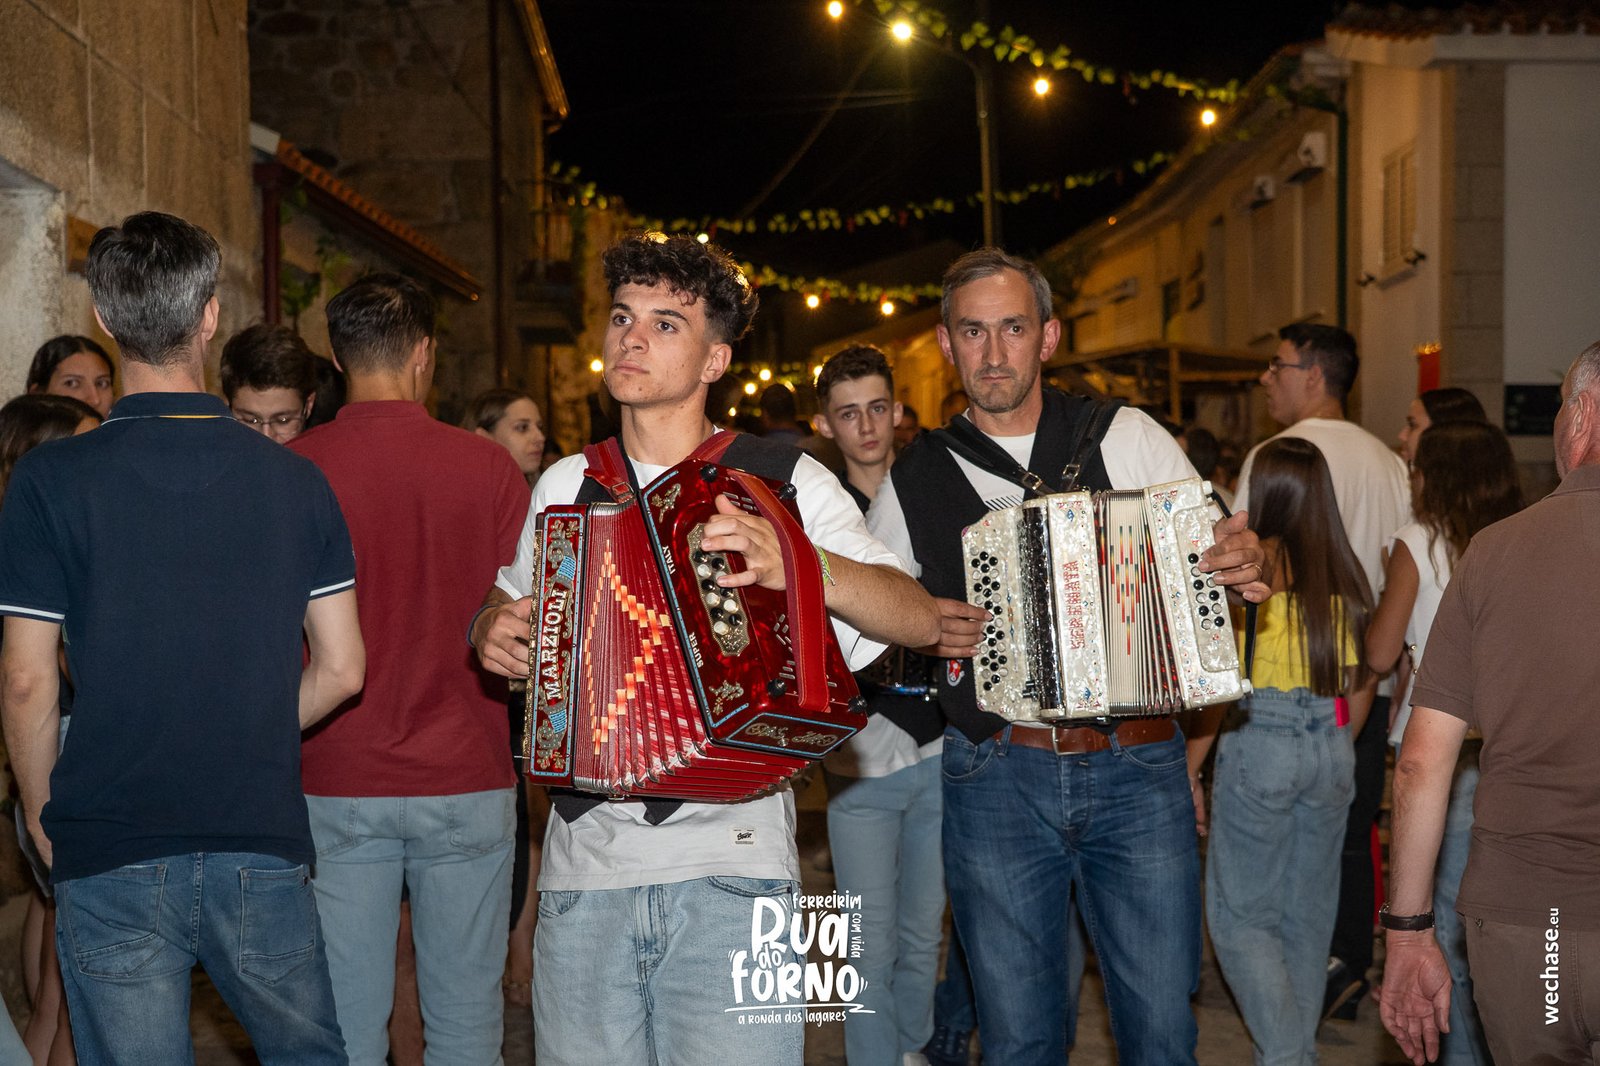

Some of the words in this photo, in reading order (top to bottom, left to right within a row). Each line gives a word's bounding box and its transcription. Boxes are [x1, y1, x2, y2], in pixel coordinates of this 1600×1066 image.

[661, 545, 676, 575] ITALY
[1062, 560, 1086, 650] SERENATA
[541, 588, 568, 700] MARZIOLI
[688, 632, 704, 669] SUPER
